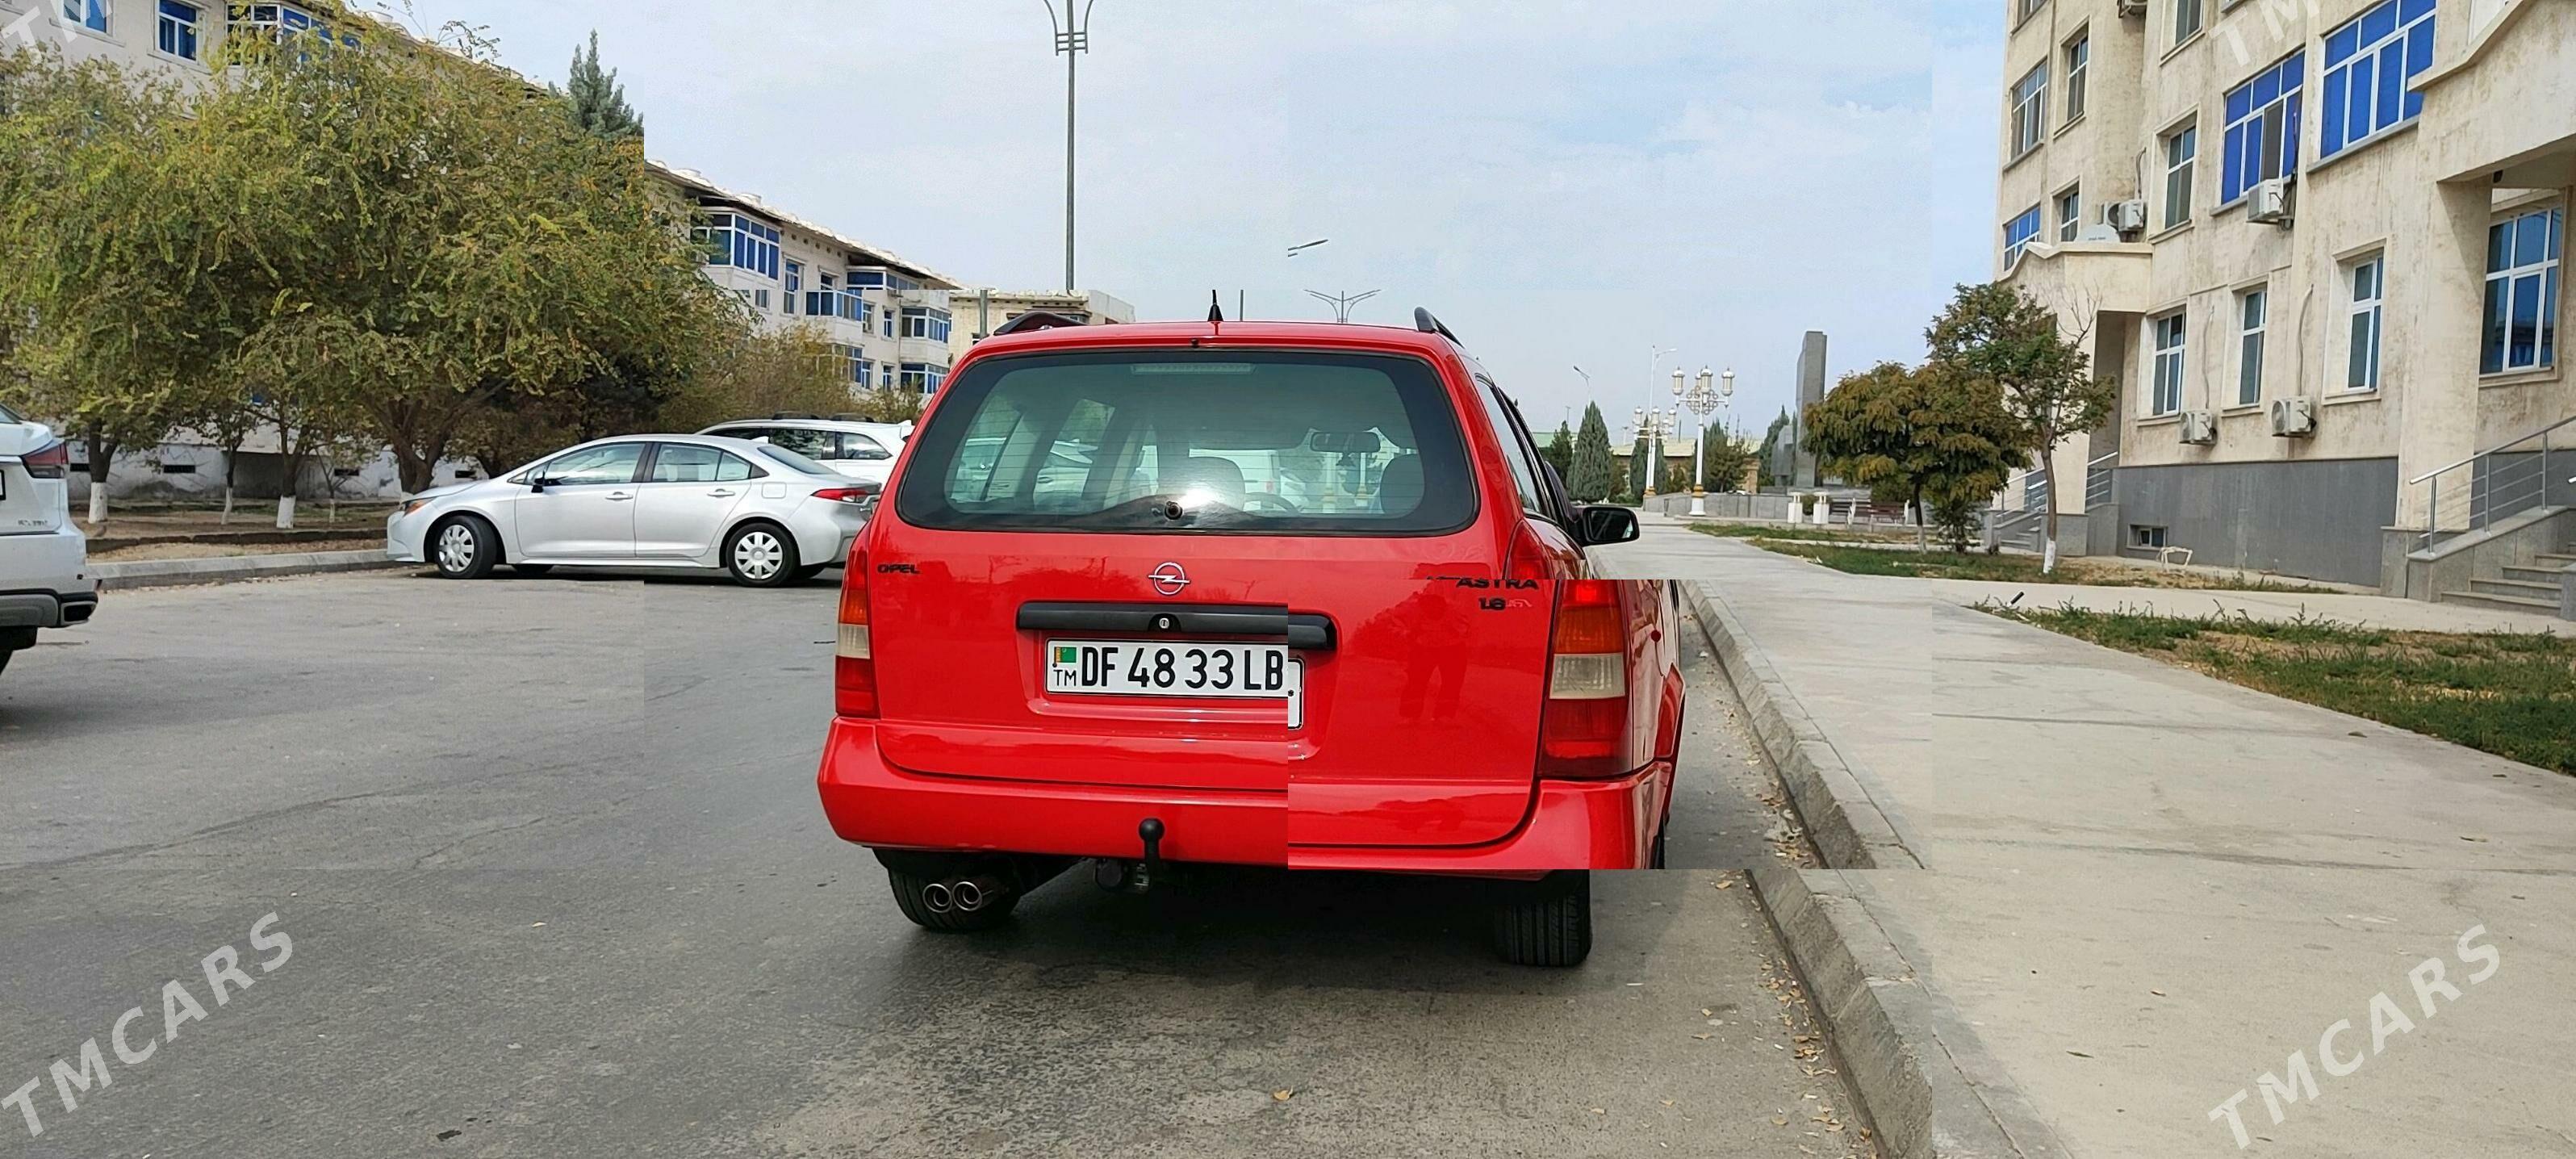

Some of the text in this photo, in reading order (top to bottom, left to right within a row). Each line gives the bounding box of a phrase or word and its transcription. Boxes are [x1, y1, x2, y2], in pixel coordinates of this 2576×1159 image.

[876, 563, 921, 574] OPEL
[1456, 578, 1539, 590] ASTRA
[1081, 646, 1283, 691] DF 48 33 LB
[1053, 669, 1077, 686] TM
